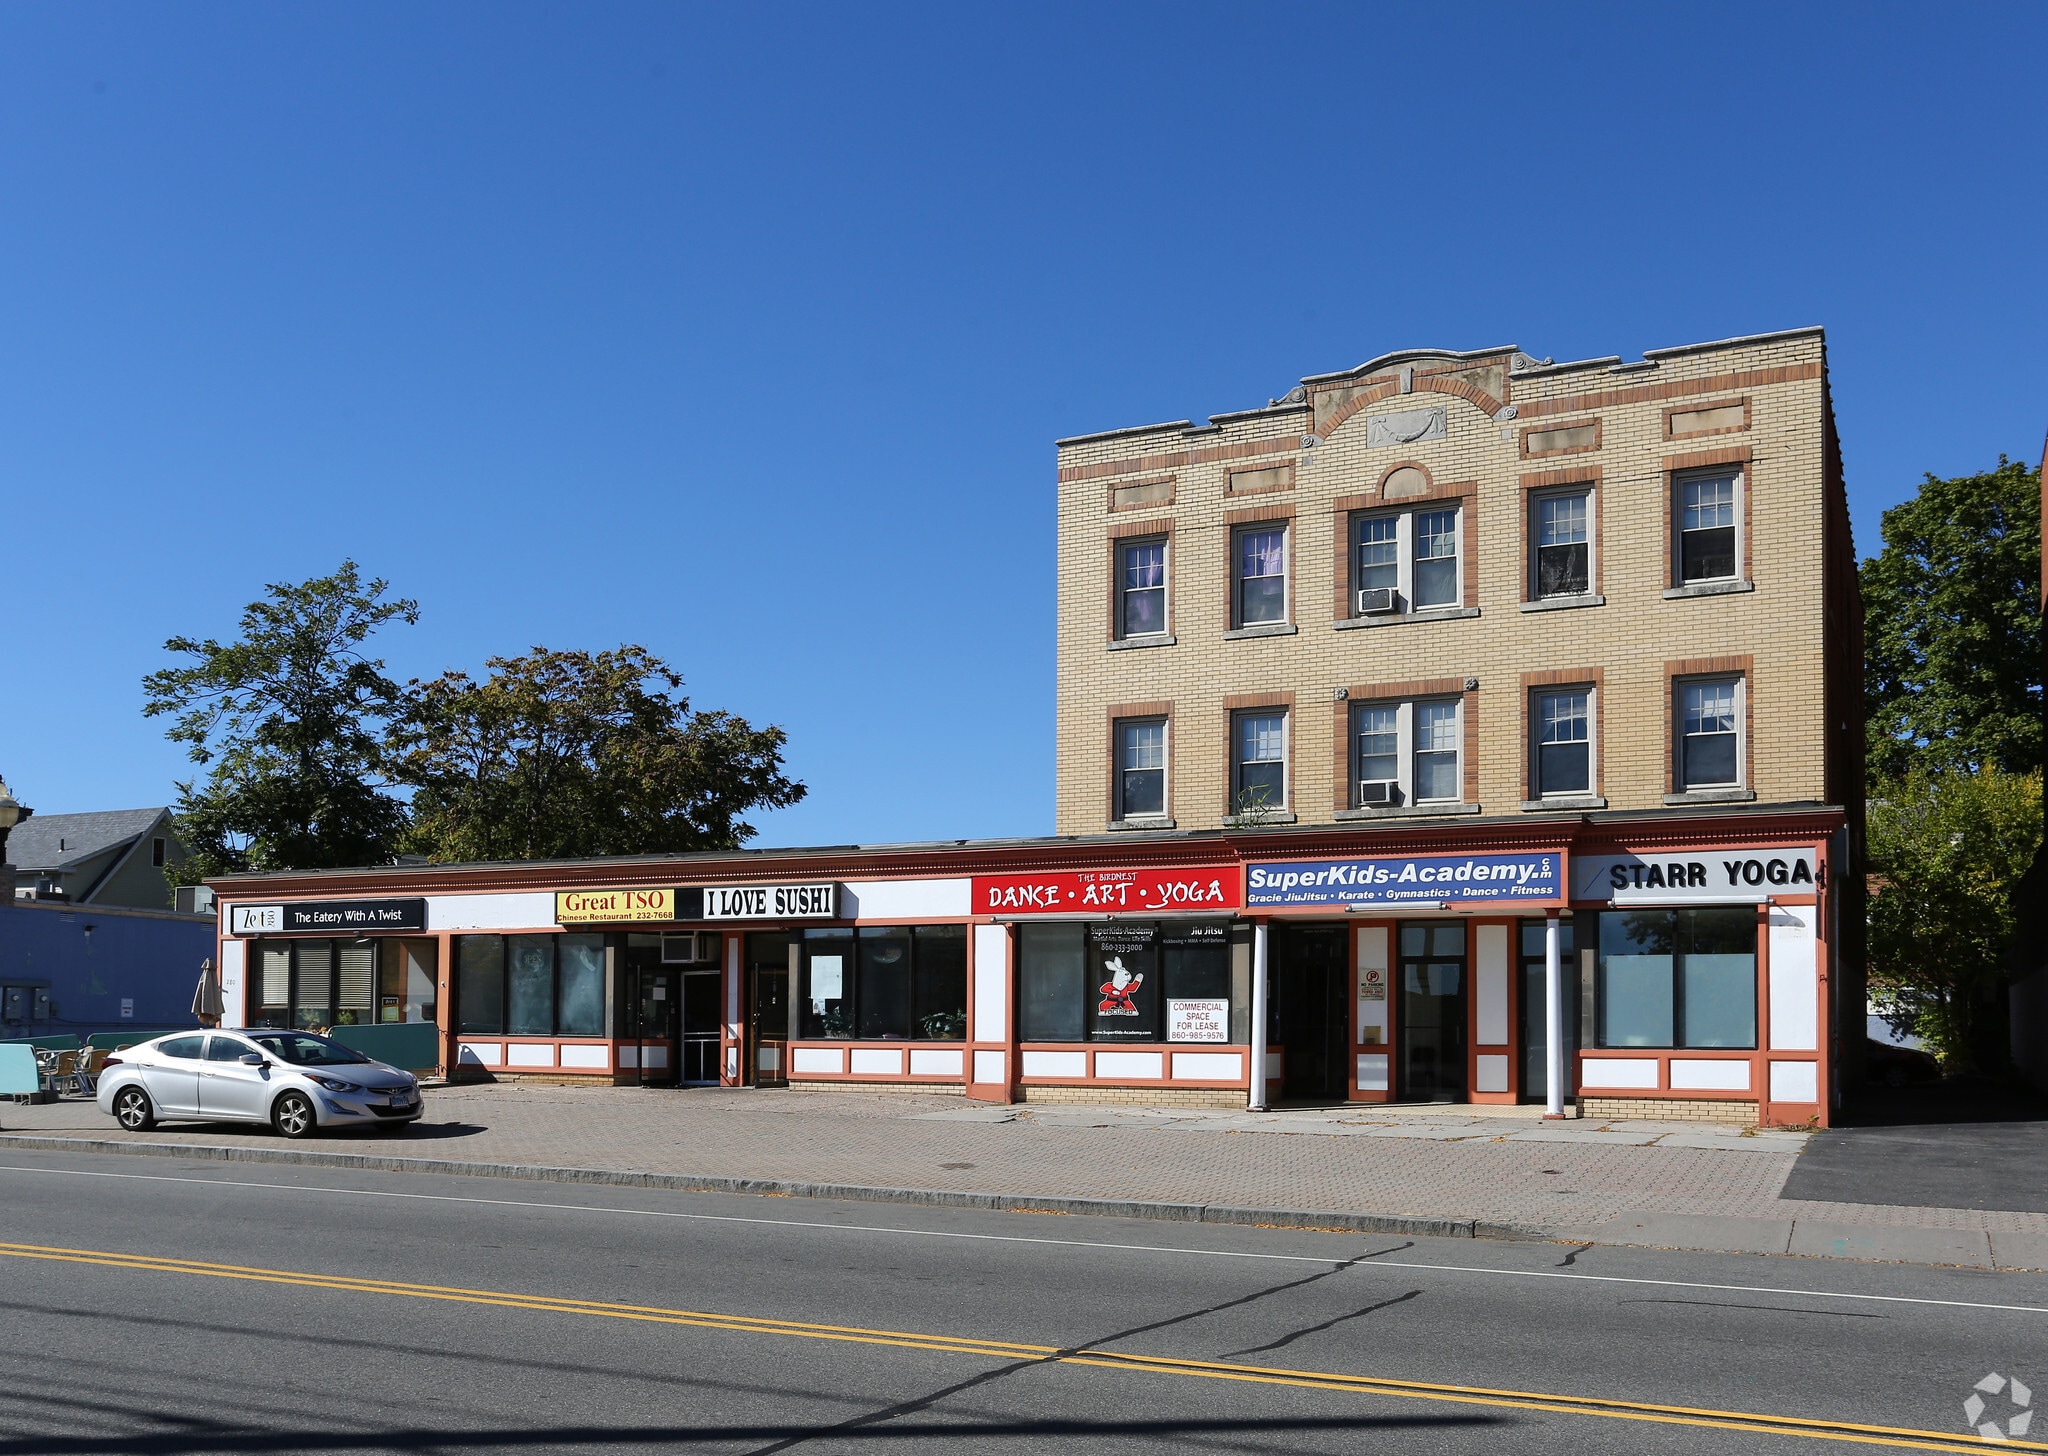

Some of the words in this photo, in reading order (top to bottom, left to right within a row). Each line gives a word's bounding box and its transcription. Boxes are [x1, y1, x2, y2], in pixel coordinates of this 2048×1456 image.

[1078, 873, 1095, 883] THE
[1099, 872, 1138, 882] BIRDNEST
[1610, 862, 1706, 890] STARR
[1722, 858, 1813, 886] YOGA
[989, 884, 1060, 908] DANCE
[1082, 882, 1134, 906] ART
[1145, 879, 1224, 909] YOGA
[1248, 893, 1282, 903] Gracie
[1284, 892, 1328, 902] JiuJitsu
[1338, 890, 1375, 900] Karate
[1386, 888, 1451, 900] Gymnastics
[1462, 887, 1499, 896] Dance
[1510, 885, 1553, 895] Fitness
[565, 893, 617, 911] Great
[622, 890, 664, 909] TSO
[707, 891, 715, 915] I
[720, 889, 767, 916] LOVE
[775, 887, 831, 915] SUSHI
[294, 912, 311, 923] The
[313, 911, 341, 923] Eatery
[344, 910, 366, 921] With
[367, 910, 376, 921] A
[378, 909, 402, 921] Twist
[636, 911, 673, 919] 232-7668
[1191, 926, 1203, 936] Jiu
[1203, 926, 1223, 935] Jitsu
[1101, 942, 1143, 953] 860-233-3000
[1173, 1002, 1223, 1011] COMMERCIAL
[1186, 1012, 1210, 1020] SPACE
[1177, 1021, 1192, 1030] FOR
[1195, 1021, 1219, 1030] LEASE
[1171, 1031, 1225, 1039] 860-985-9576
